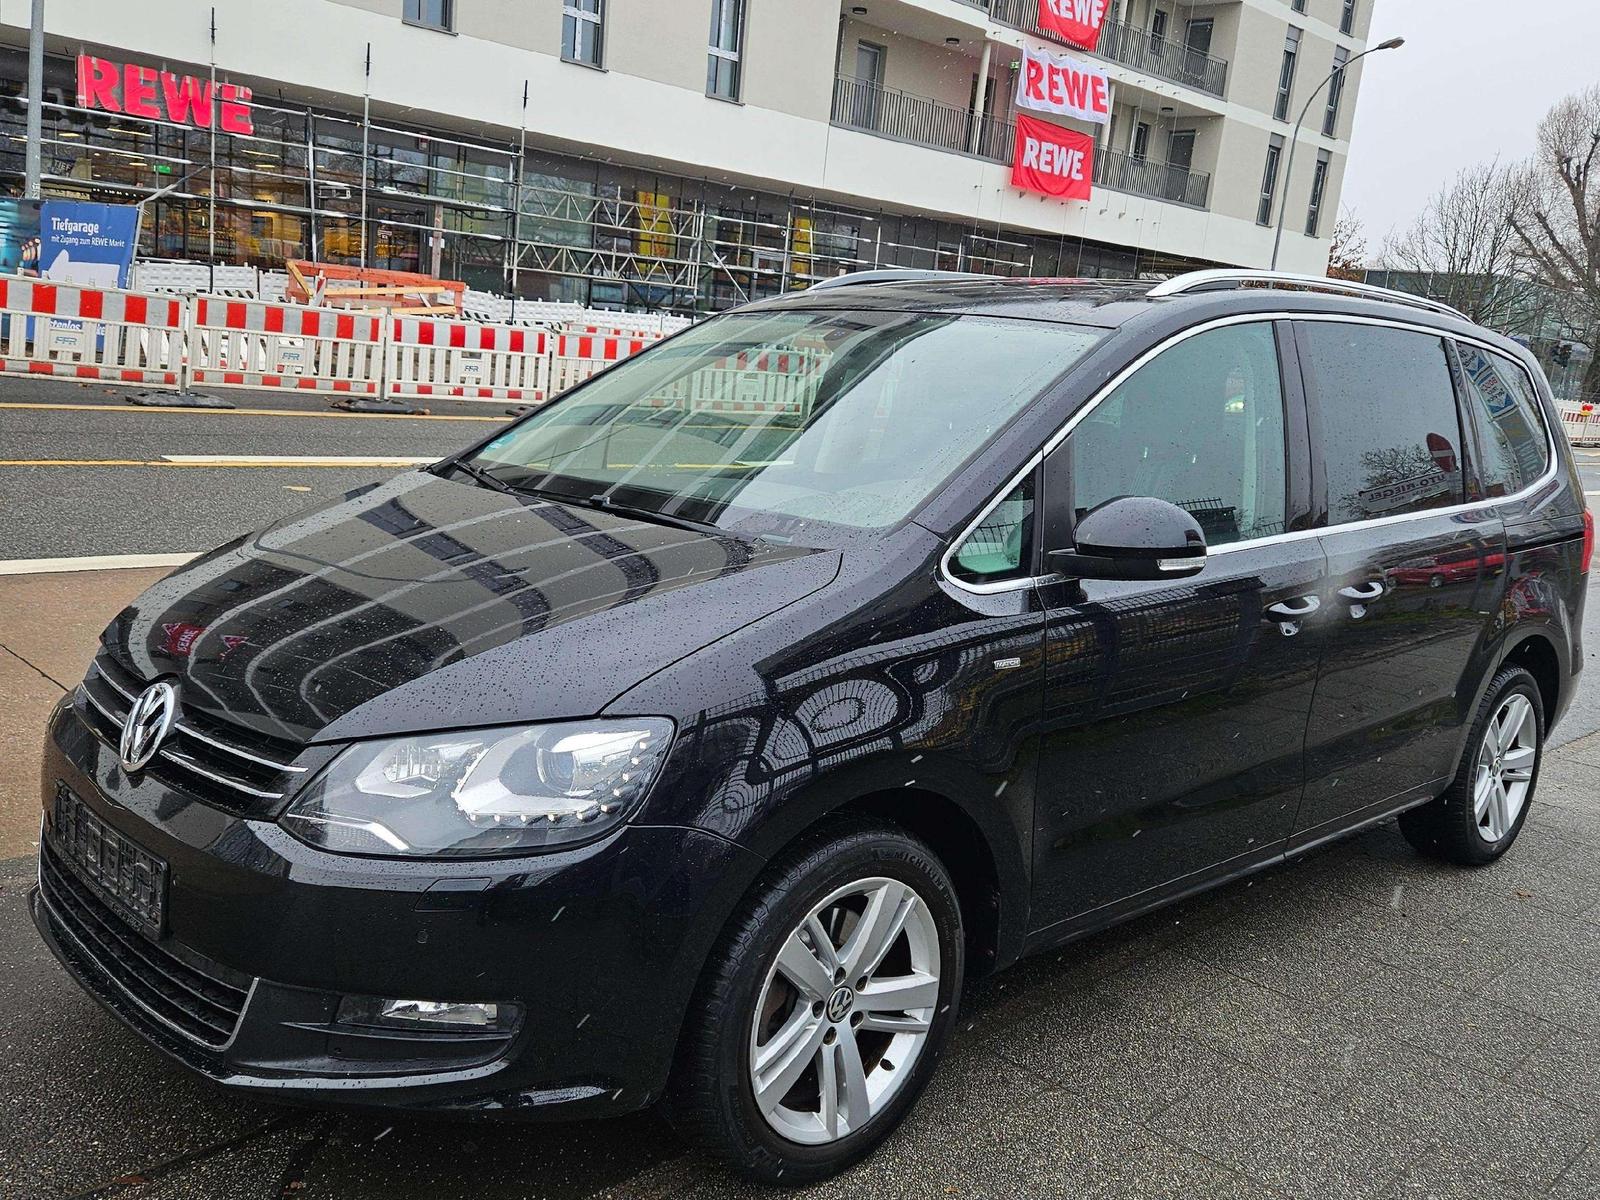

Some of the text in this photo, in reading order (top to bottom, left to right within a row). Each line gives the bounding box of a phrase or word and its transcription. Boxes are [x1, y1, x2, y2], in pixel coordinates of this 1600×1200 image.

[76, 55, 255, 135] REWE
[1025, 57, 1108, 114] REWE
[1023, 136, 1085, 181] REWE
[51, 217, 99, 235] Tiefgarage
[51, 235, 60, 243] mit
[60, 235, 79, 246] Zugang
[91, 237, 109, 246] REWE
[109, 239, 125, 248] Markt
